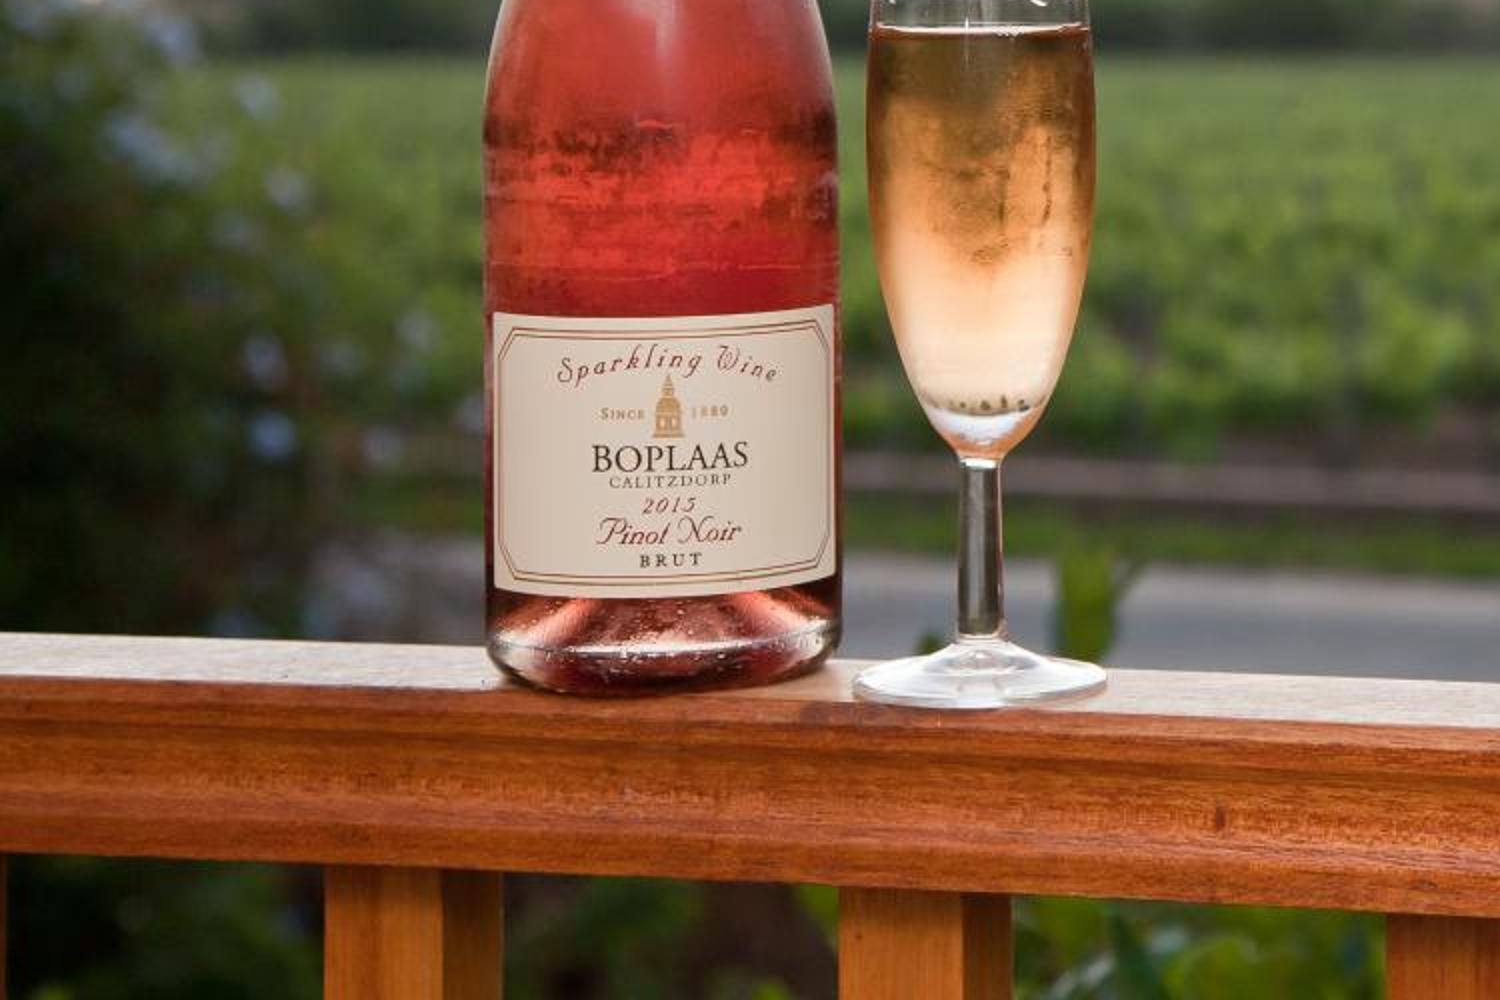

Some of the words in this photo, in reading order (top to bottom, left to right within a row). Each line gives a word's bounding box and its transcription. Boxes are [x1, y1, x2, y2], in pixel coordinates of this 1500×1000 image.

[557, 343, 702, 388] Sparkling
[717, 344, 777, 382] Wine
[592, 441, 749, 473] BOPLAAS
[609, 474, 732, 489] CALITZDORP
[643, 497, 697, 514] 2015
[596, 517, 671, 545] Pinot
[676, 515, 742, 544] Noir
[640, 552, 703, 568] BRUT
